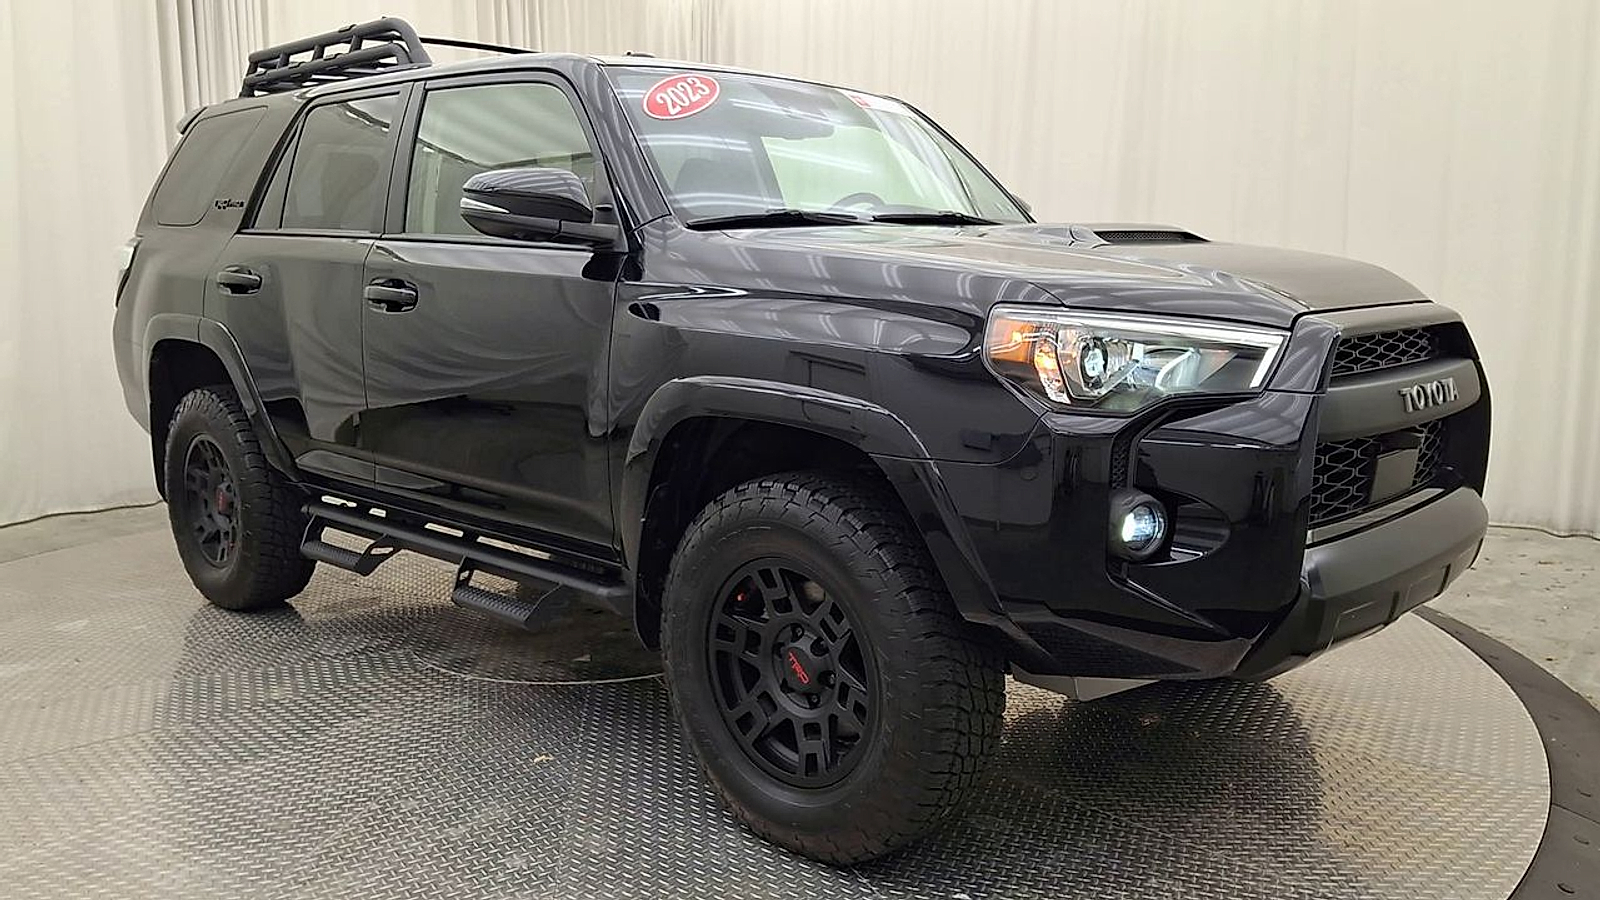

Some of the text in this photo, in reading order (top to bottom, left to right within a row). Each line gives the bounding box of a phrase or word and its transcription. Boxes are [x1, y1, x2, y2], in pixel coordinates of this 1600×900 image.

[656, 77, 710, 115] 2023
[1399, 377, 1459, 413] TOYOTA
[788, 651, 809, 684] TRD
